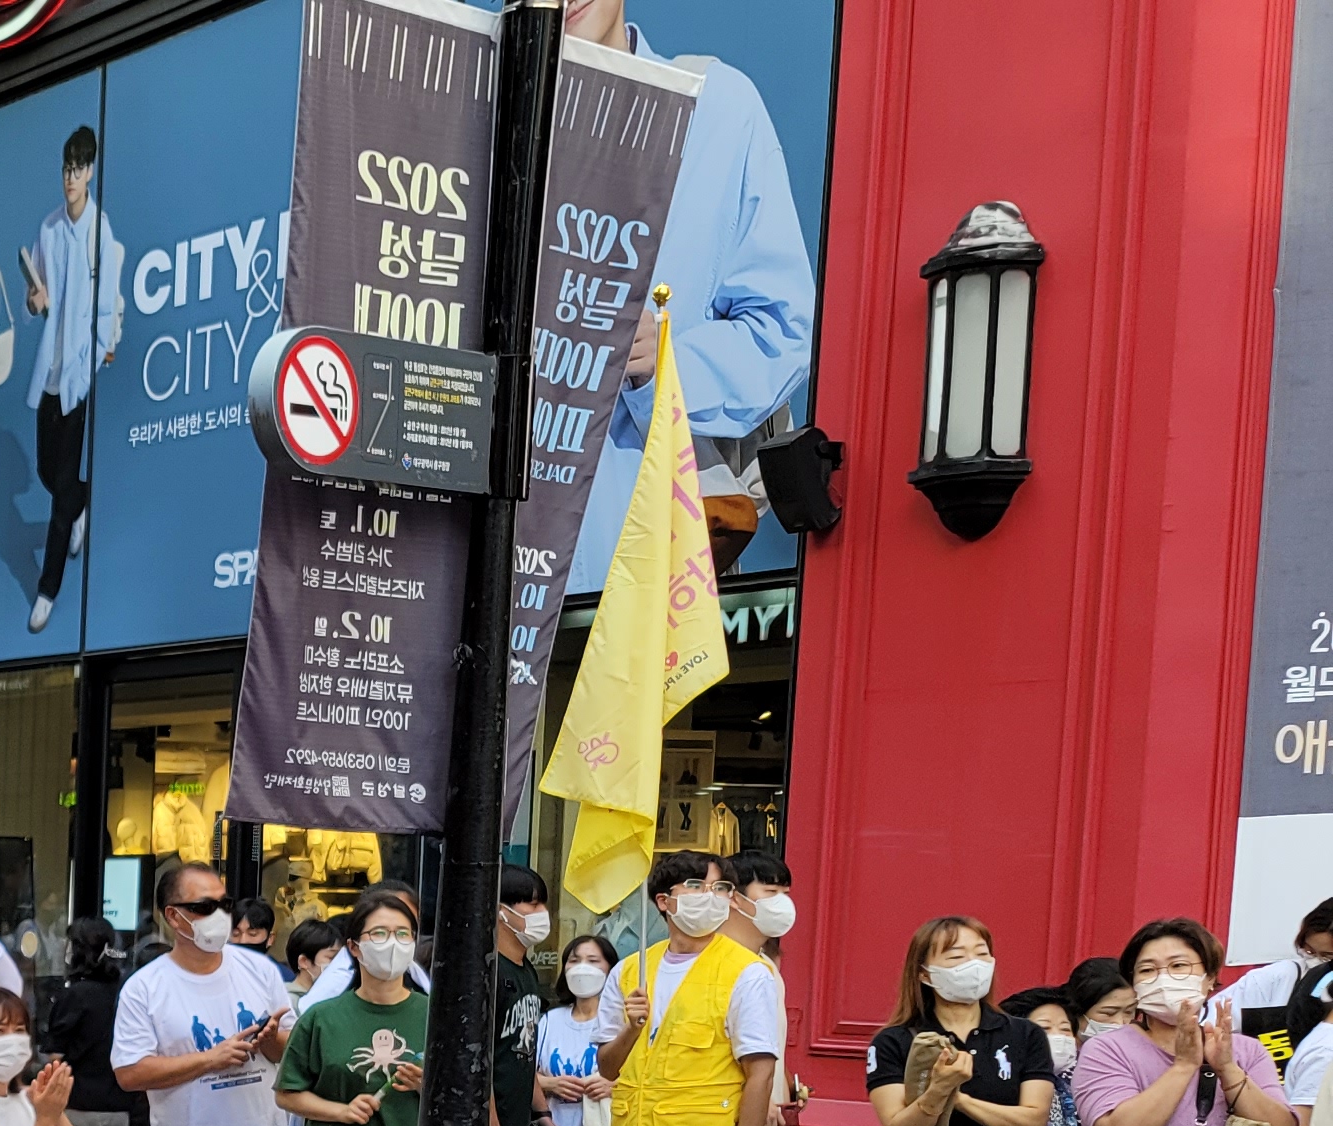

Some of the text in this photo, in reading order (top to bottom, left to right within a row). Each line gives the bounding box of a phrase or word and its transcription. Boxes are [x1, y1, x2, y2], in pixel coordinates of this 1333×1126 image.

[133, 218, 265, 315] CITY
[142, 315, 254, 401] CITY
[128, 402, 242, 447] 우리가 사랑한 도시의
